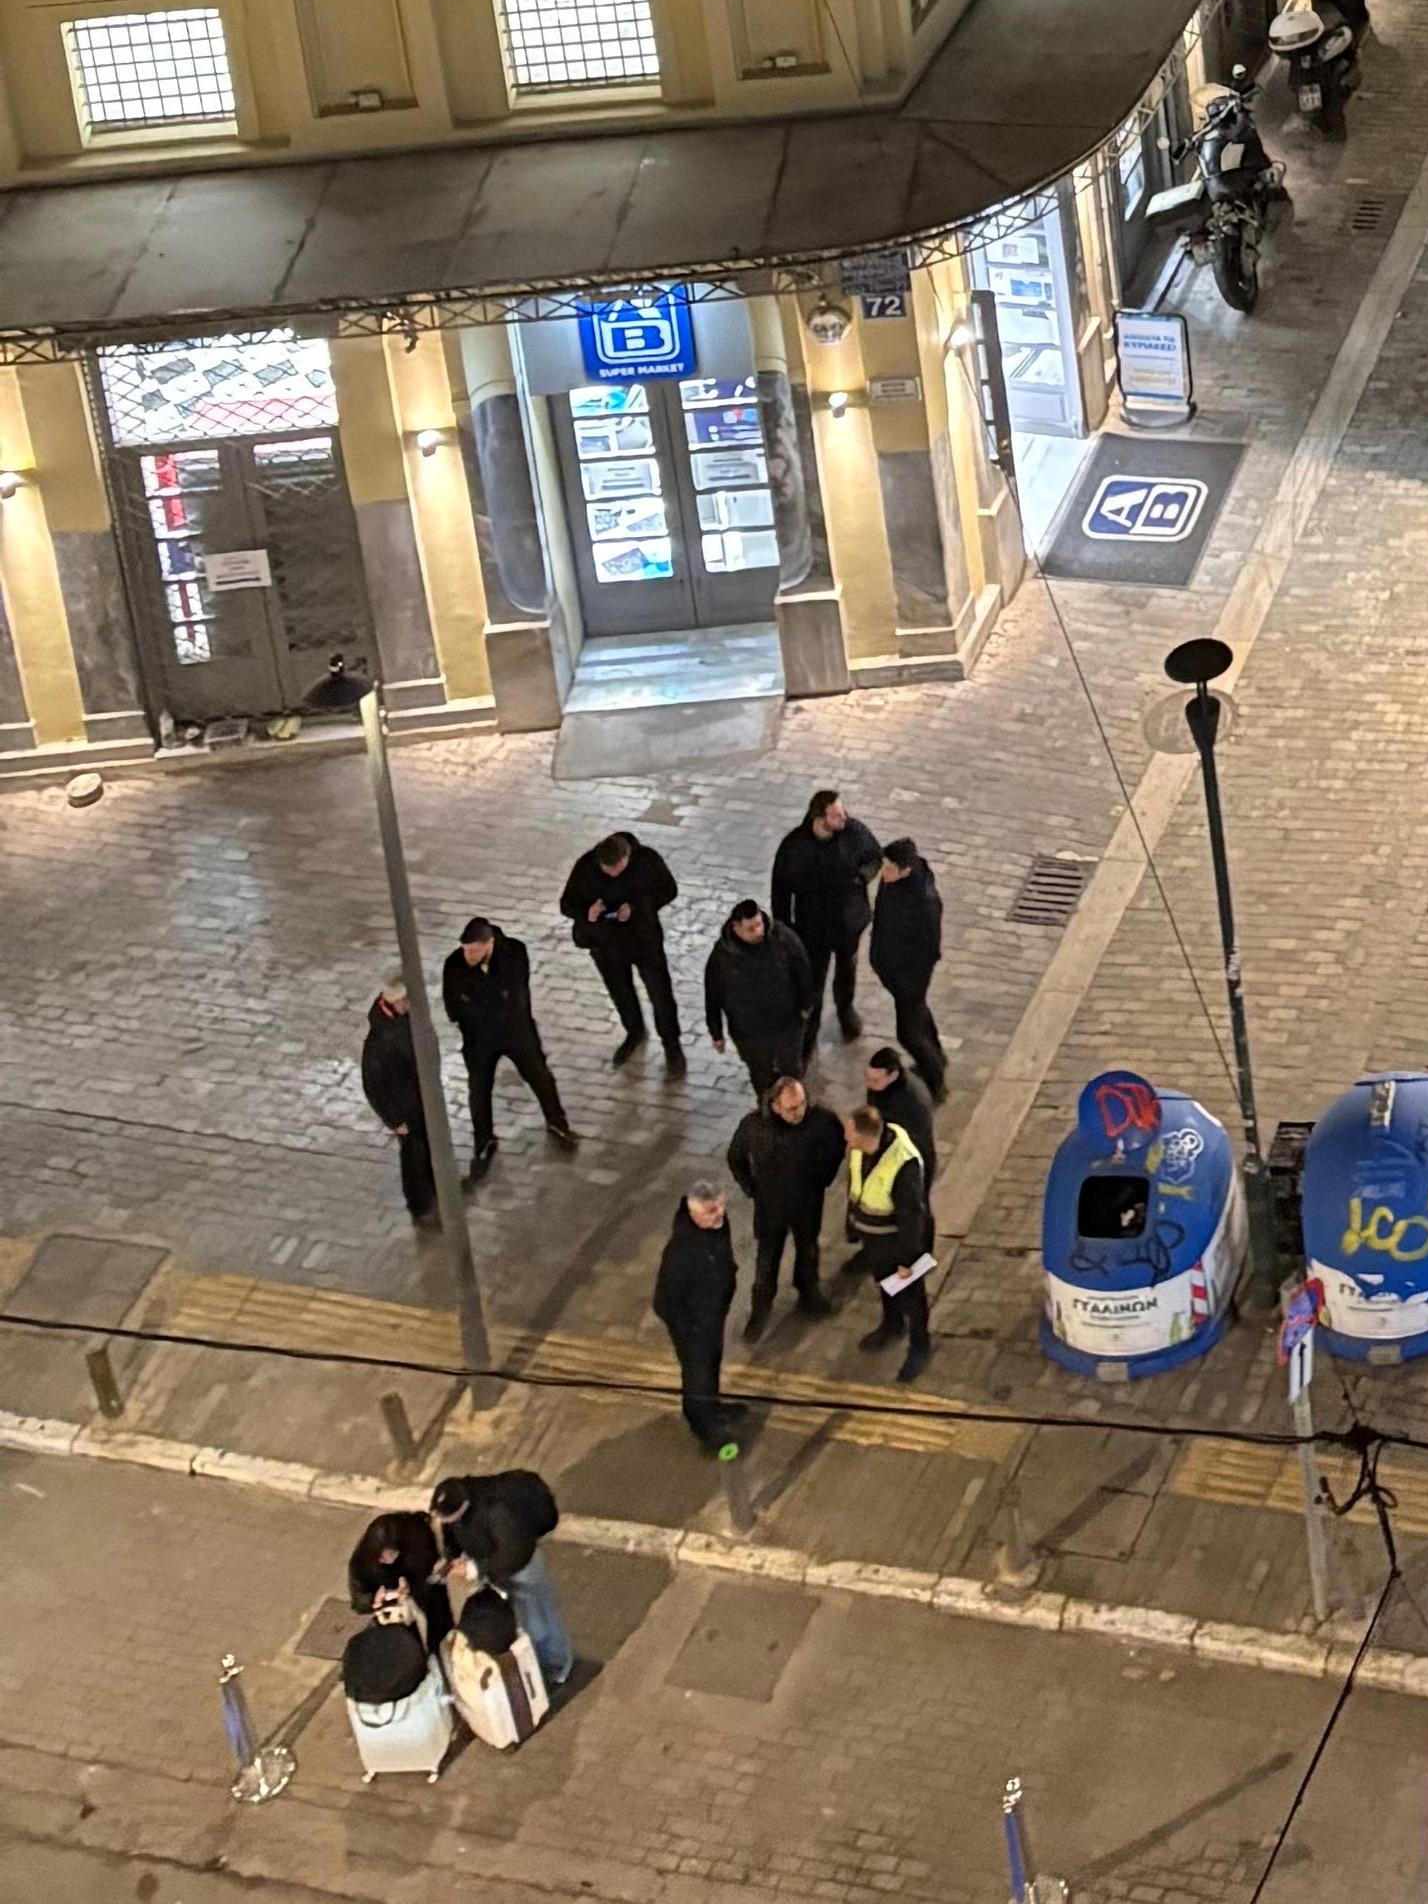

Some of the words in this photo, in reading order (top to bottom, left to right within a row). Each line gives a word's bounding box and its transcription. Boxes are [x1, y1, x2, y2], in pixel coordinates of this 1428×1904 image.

[866, 296, 902, 316] 72
[599, 366, 635, 378] SUPER
[637, 363, 685, 375] MARKET
